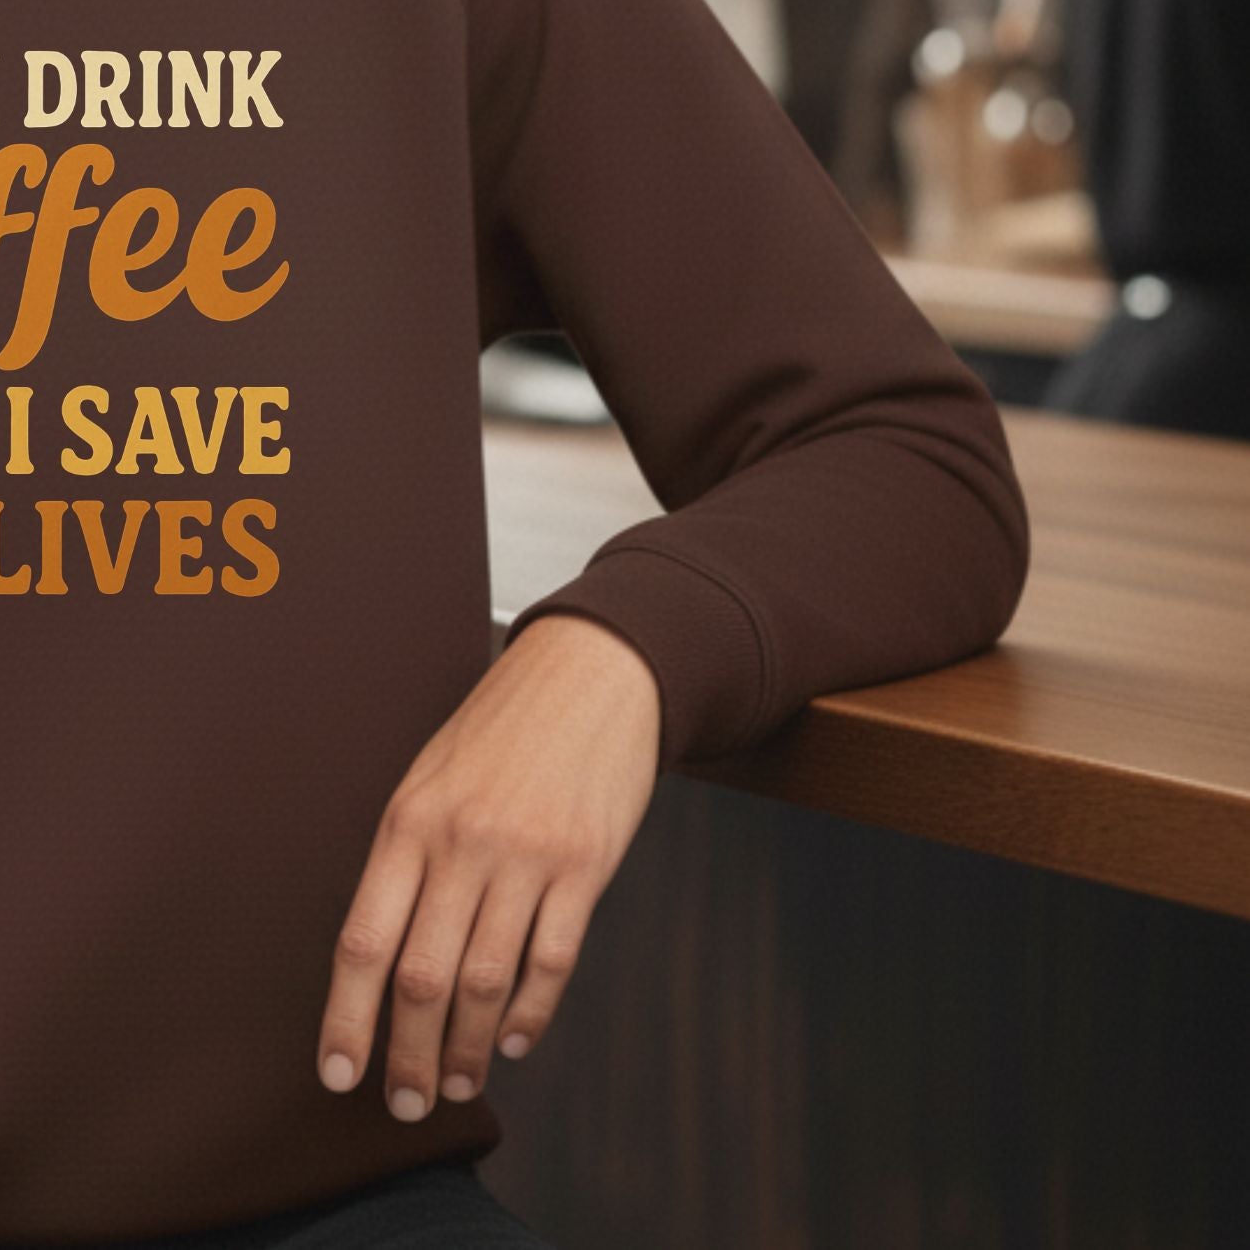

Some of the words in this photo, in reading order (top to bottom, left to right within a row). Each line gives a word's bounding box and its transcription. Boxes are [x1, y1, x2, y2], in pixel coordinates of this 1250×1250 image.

[24, 50, 284, 128] DRINK
[6, 386, 34, 475] I
[61, 385, 290, 476] SAVE
